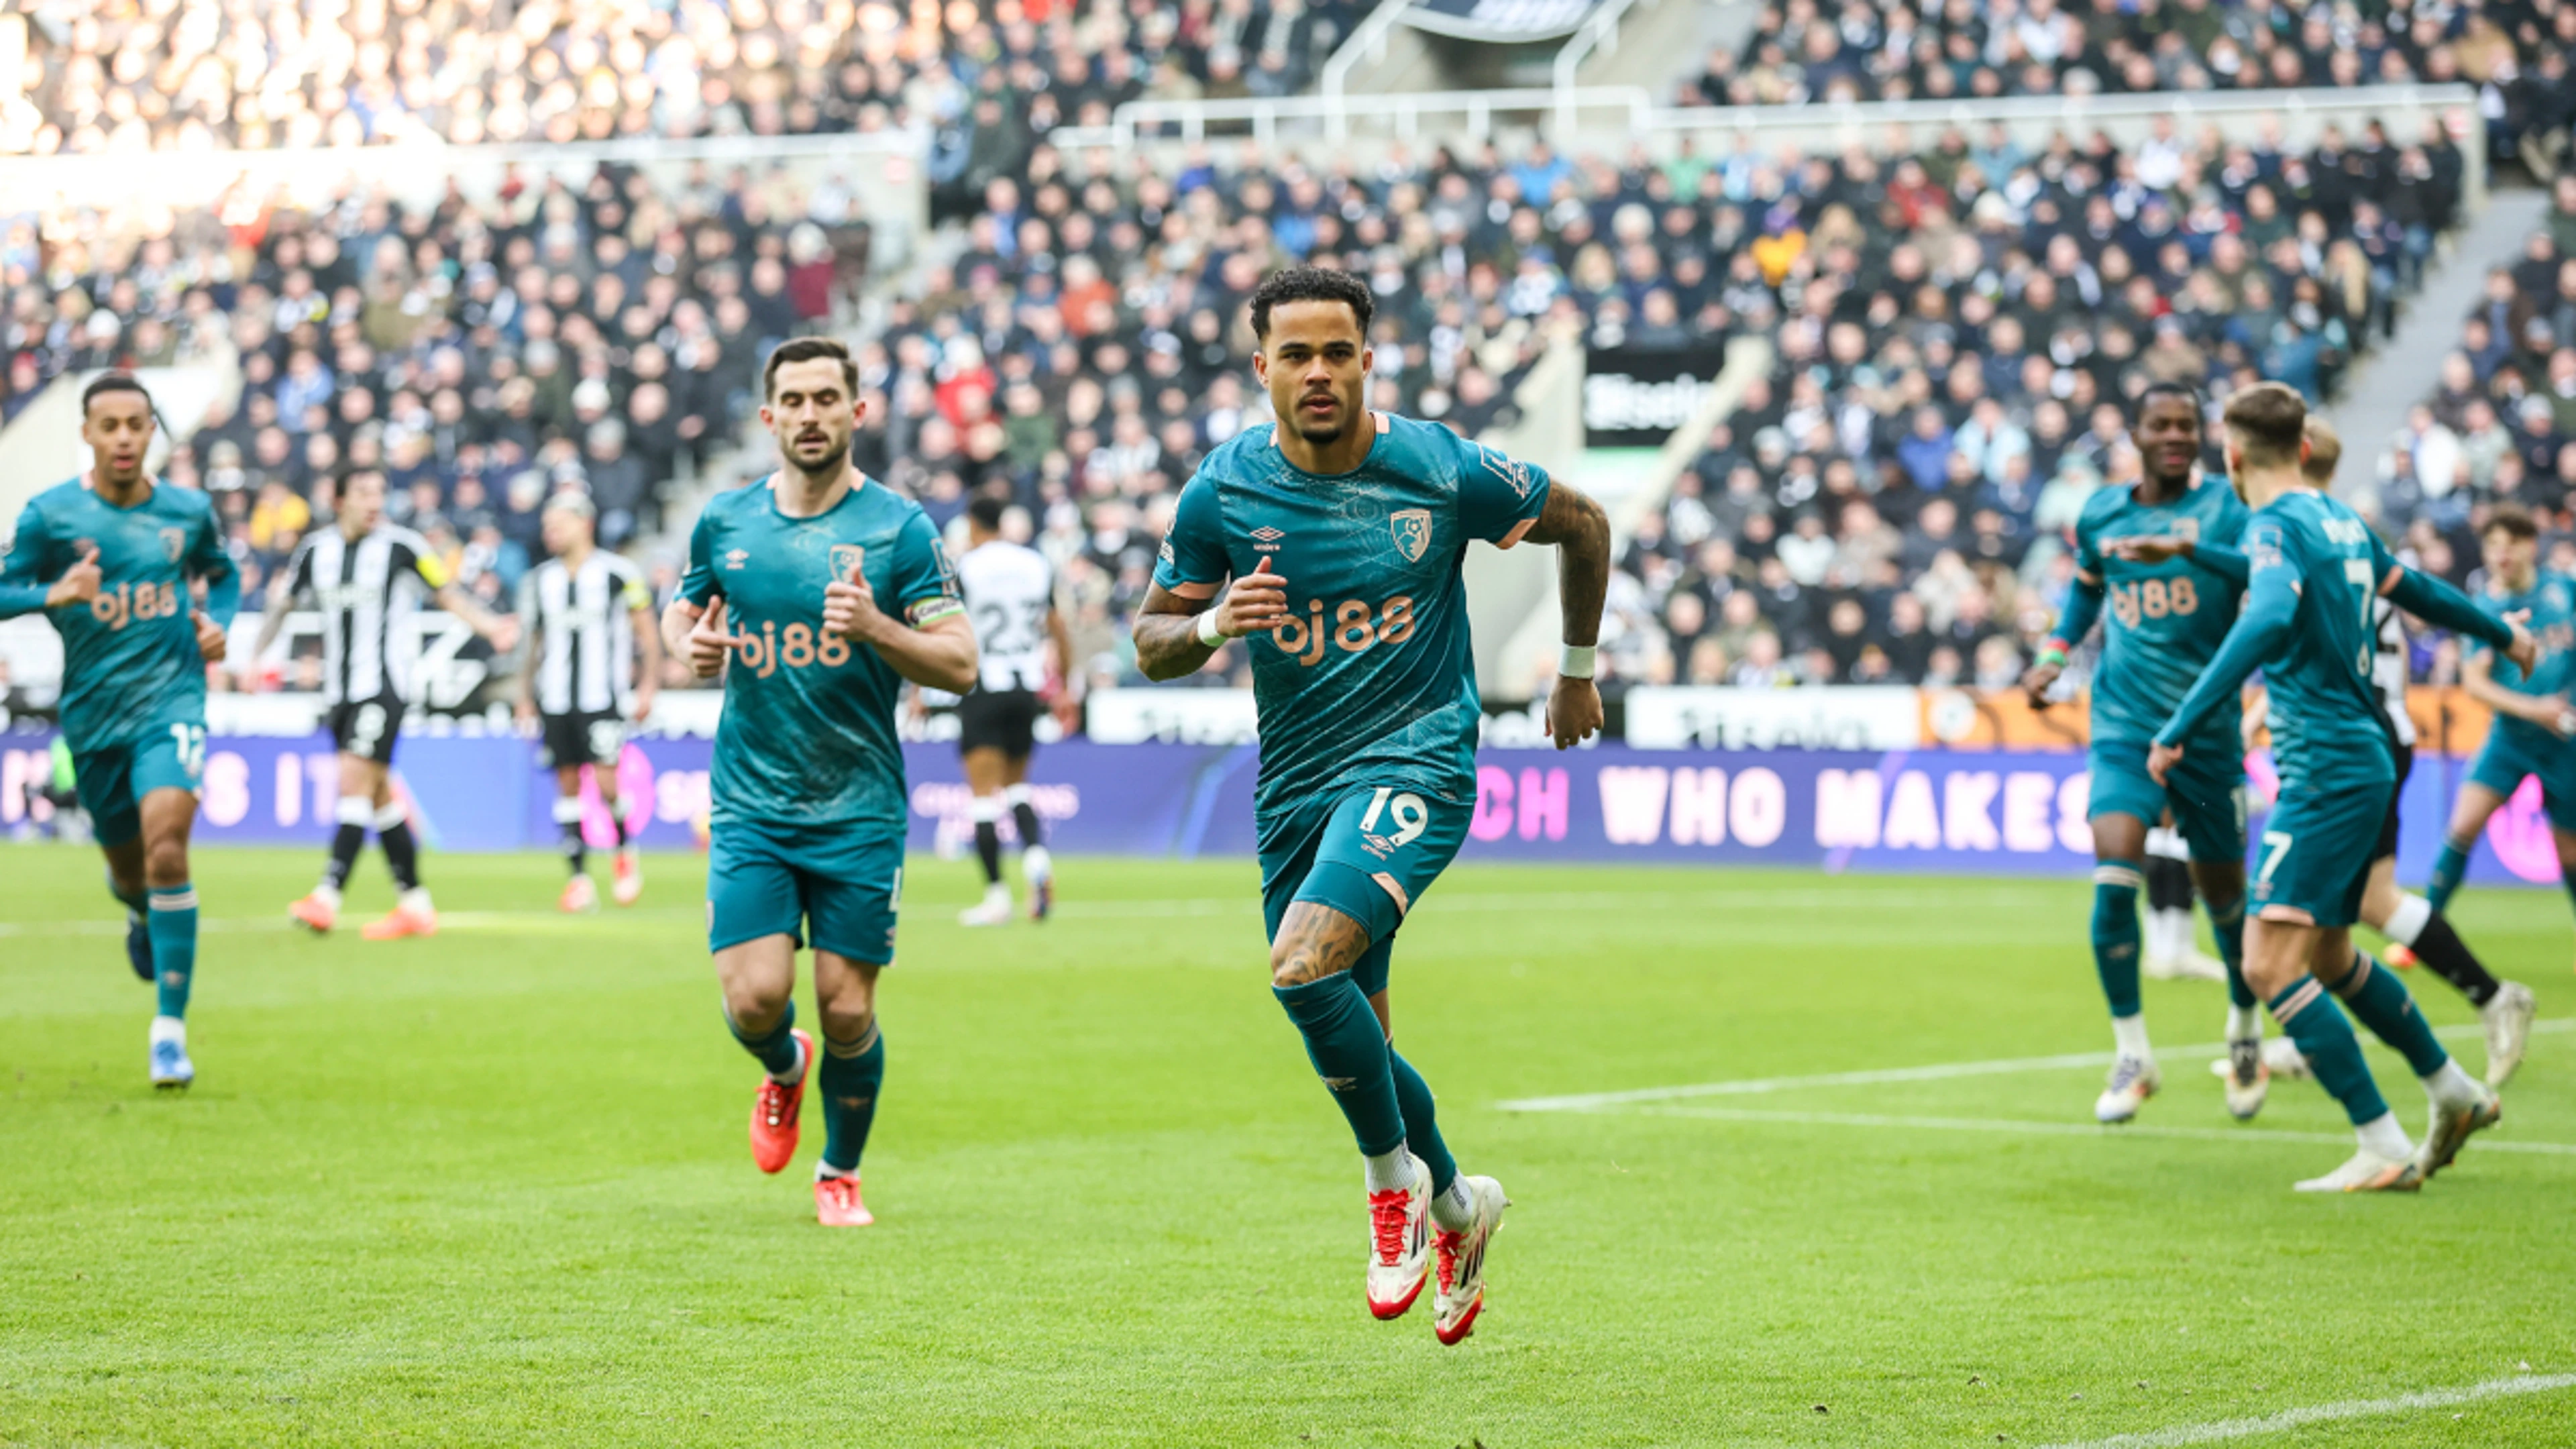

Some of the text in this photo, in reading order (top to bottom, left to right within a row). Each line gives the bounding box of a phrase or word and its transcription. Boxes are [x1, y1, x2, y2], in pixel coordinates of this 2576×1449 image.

[2344, 558, 2375, 631] 7
[739, 620, 851, 679] bj88
[1359, 786, 1428, 847] 19
[1598, 765, 1786, 847] WHO
[1815, 768, 2094, 854] MAKES
[2259, 830, 2293, 883] 7
